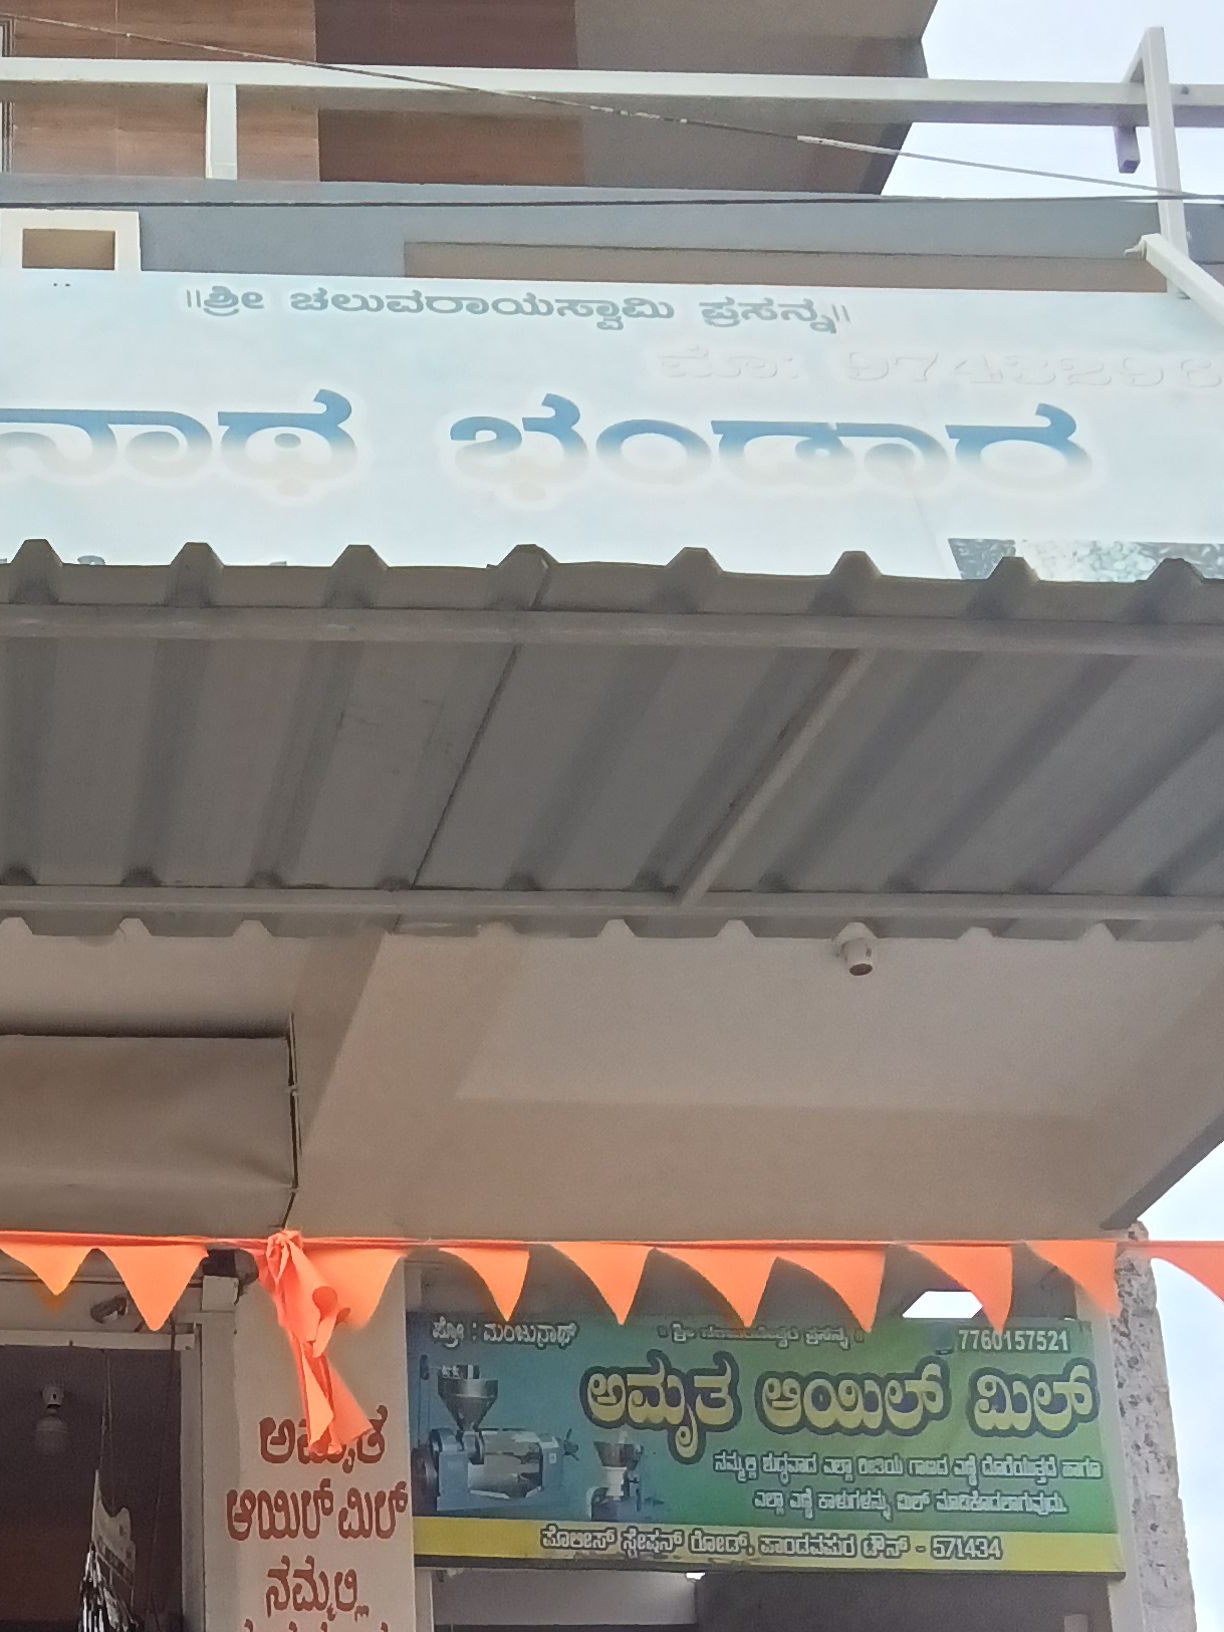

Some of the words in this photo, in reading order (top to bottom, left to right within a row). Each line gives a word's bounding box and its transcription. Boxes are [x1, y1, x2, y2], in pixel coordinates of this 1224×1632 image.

[450, 392, 1092, 502] ಭಂಡಾರ
[959, 1329, 1069, 1351] 7760157521
[584, 1356, 740, 1460] ಅಮೃತ
[758, 1358, 946, 1434] ಆಯಿಲ್
[973, 1360, 1096, 1434] ಮಿಲ್
[227, 1478, 334, 1541] ಆಯಿಲ್
[338, 1480, 409, 1540] ಮಿಲ್
[932, 1536, 1002, 1558] 571434
